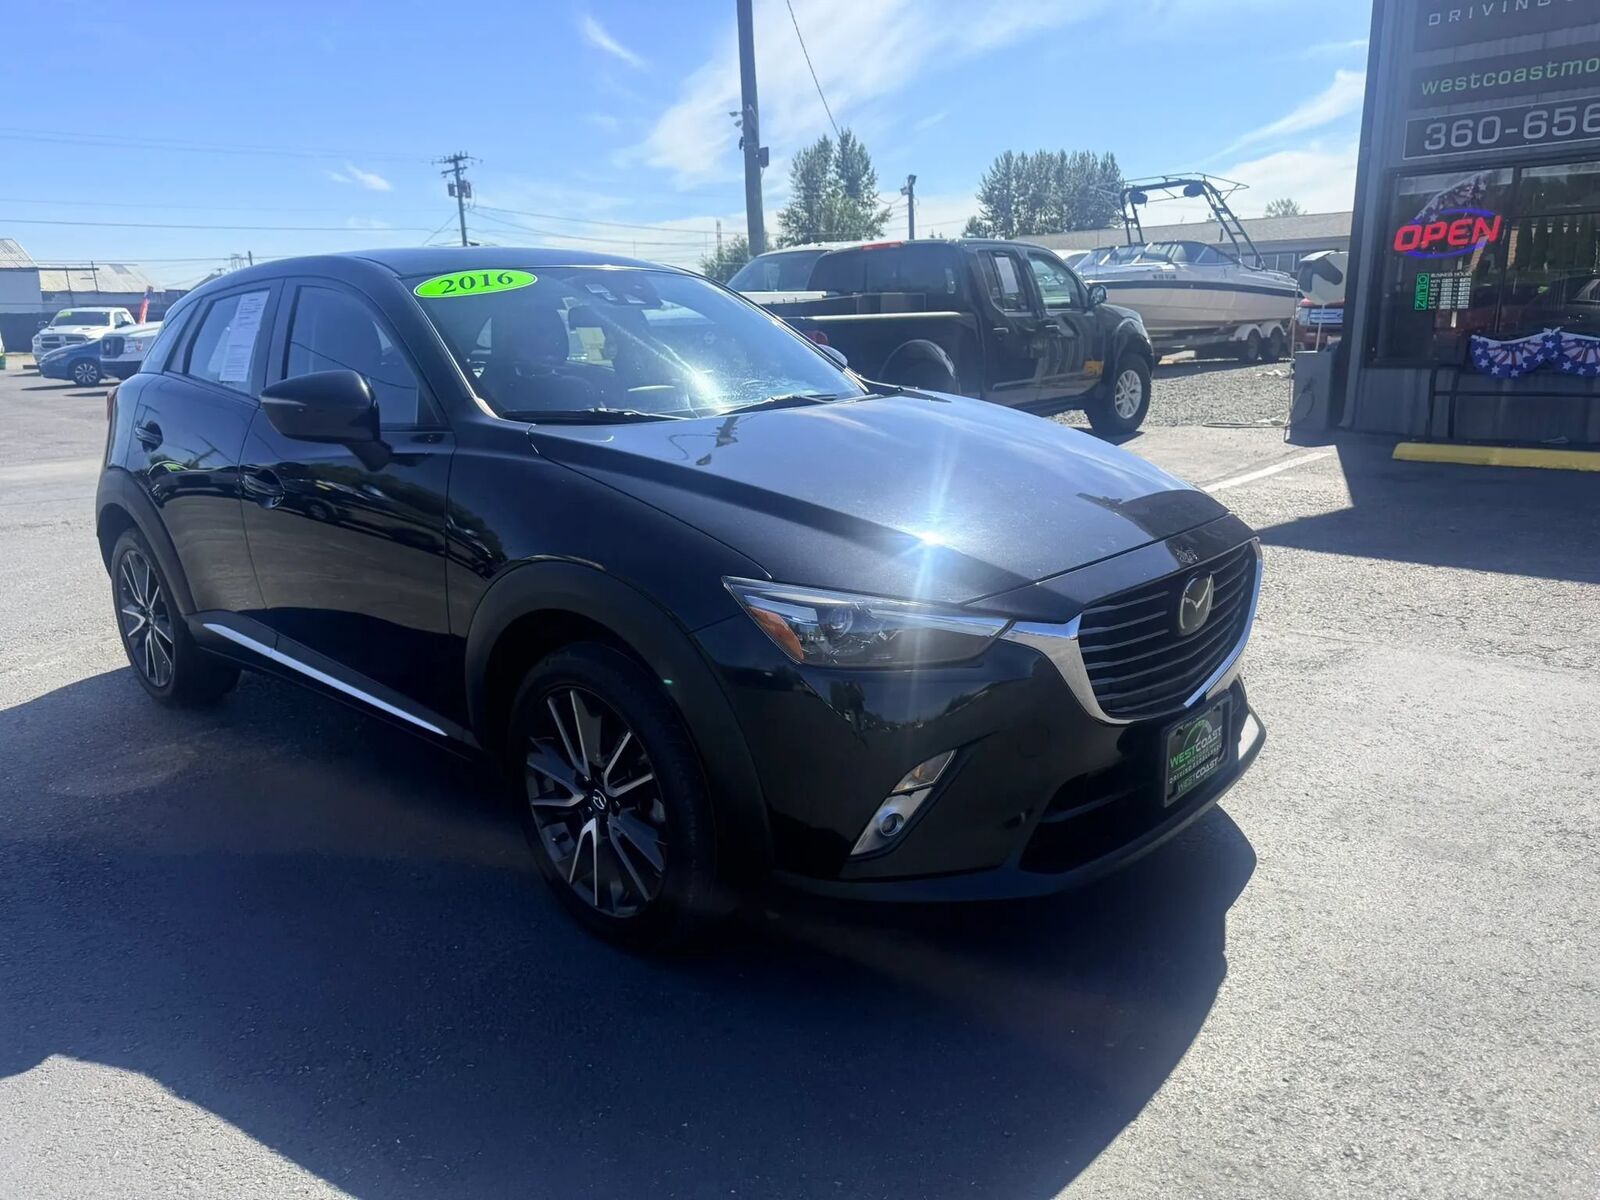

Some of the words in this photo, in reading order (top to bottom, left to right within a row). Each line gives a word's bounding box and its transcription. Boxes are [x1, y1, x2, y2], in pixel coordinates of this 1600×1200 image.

[1421, 57, 1600, 96] westcoastmo
[1423, 103, 1600, 151] 360-656
[1393, 215, 1502, 252] OPEN
[438, 271, 514, 294] 2016
